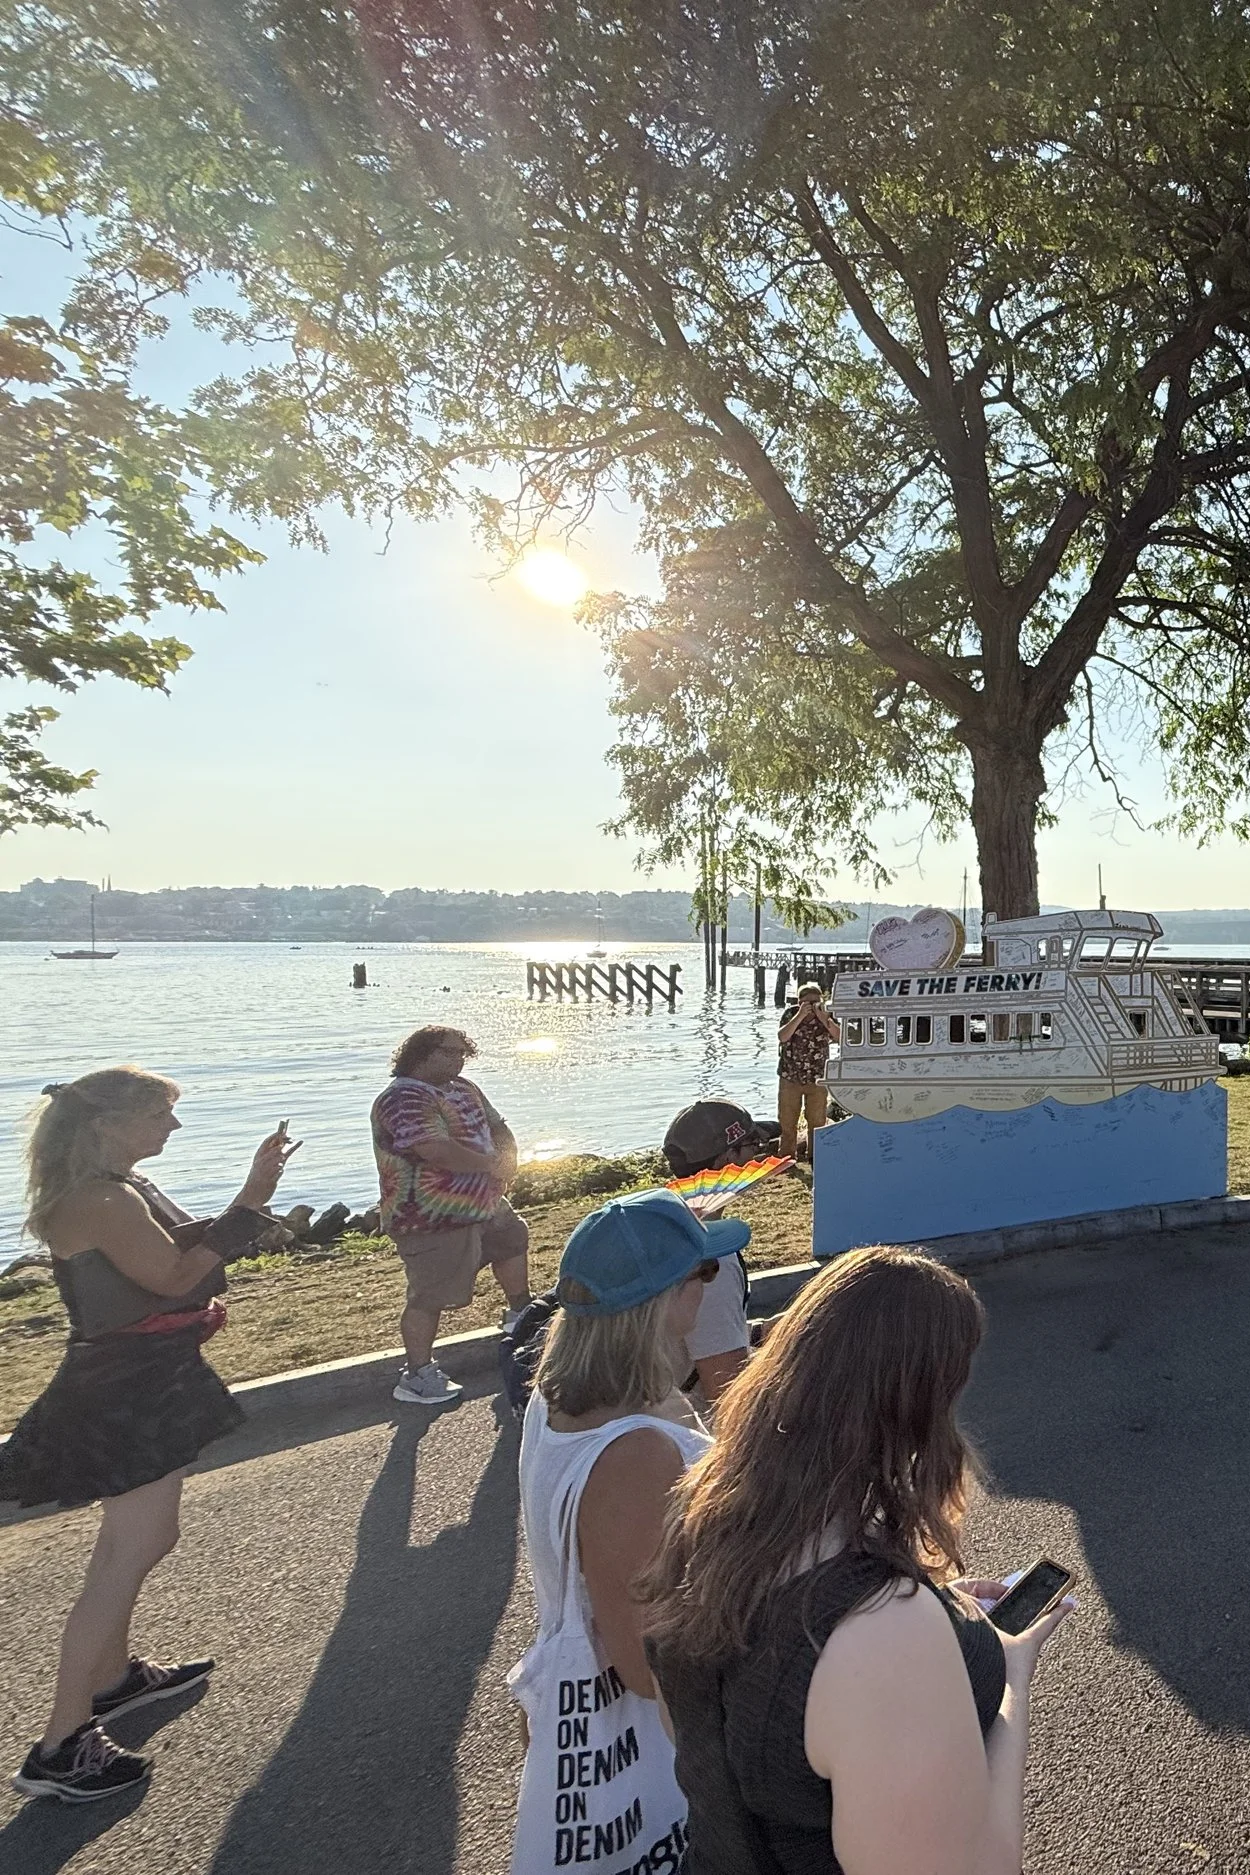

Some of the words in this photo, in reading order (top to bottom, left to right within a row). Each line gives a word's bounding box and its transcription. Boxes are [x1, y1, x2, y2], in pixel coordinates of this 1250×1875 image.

[857, 978, 912, 998] SAVE
[916, 976, 958, 995] THE
[963, 972, 1042, 993] FERRY!
[557, 1716, 589, 1750] ON
[557, 1726, 640, 1790] DENIM
[555, 1791, 587, 1825] ON
[554, 1797, 643, 1866] DENIM
